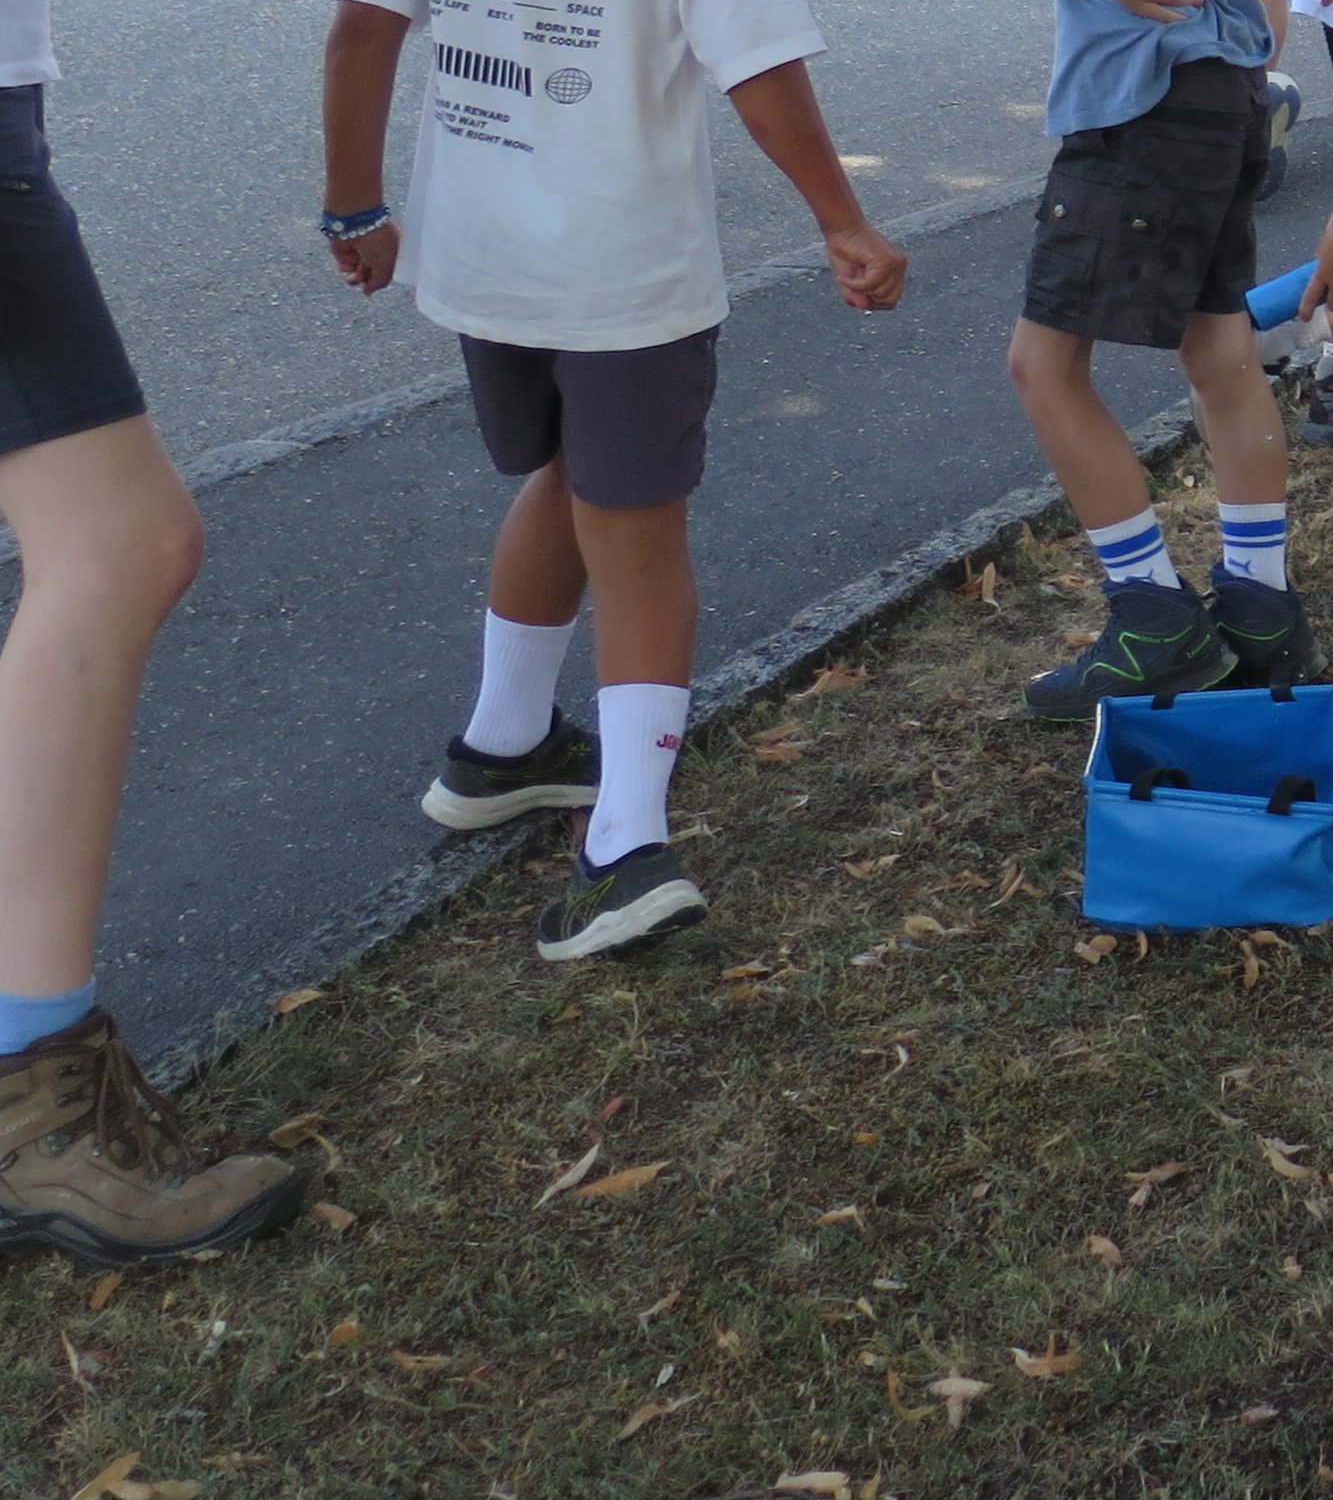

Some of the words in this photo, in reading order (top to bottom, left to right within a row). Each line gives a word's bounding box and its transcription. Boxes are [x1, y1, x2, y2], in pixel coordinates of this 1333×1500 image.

[566, 3, 605, 18] SPACE
[536, 21, 567, 34] BORN
[570, 25, 585, 36] TO
[587, 28, 602, 38] BE
[523, 31, 546, 44] THE
[549, 35, 600, 49] COOLEST
[459, 116, 488, 129] WAIT
[463, 105, 511, 123] REWARD
